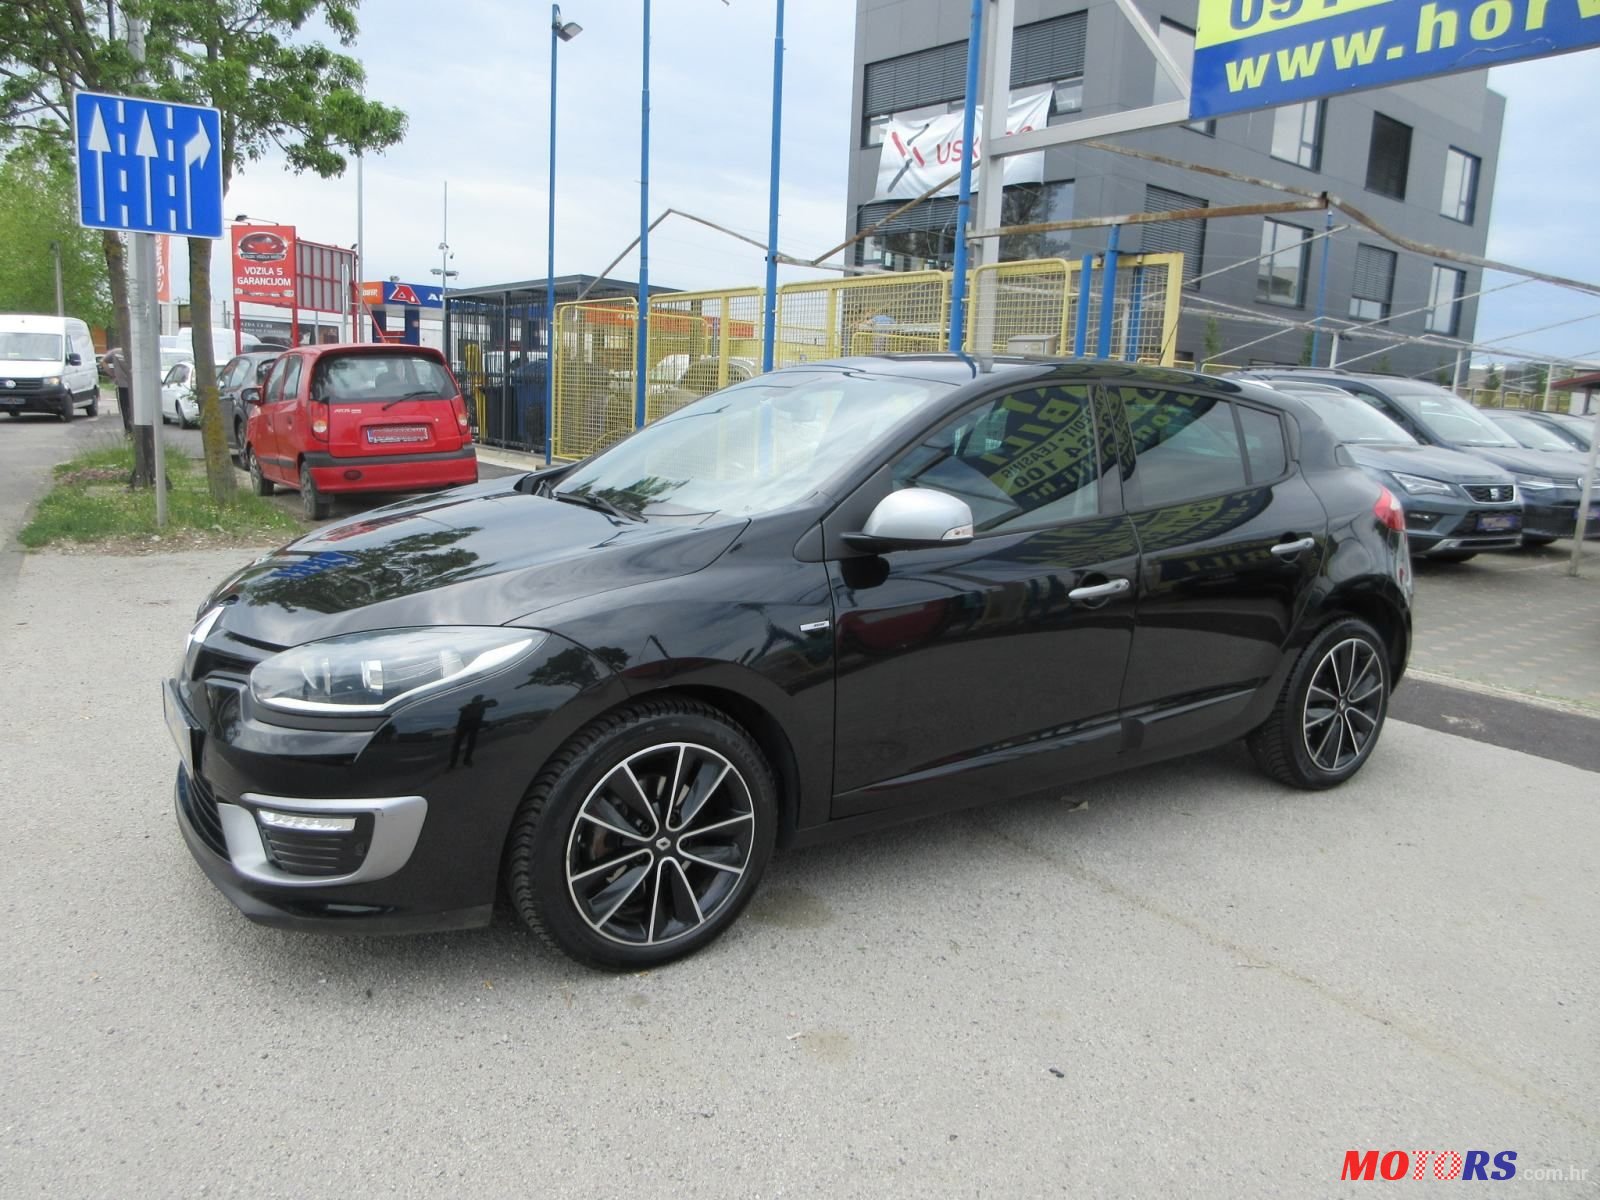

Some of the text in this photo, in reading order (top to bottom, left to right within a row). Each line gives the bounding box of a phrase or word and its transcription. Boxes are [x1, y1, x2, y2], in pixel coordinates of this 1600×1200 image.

[244, 266, 284, 276] VOZILA S
[237, 277, 292, 287] GARANCIJOM
